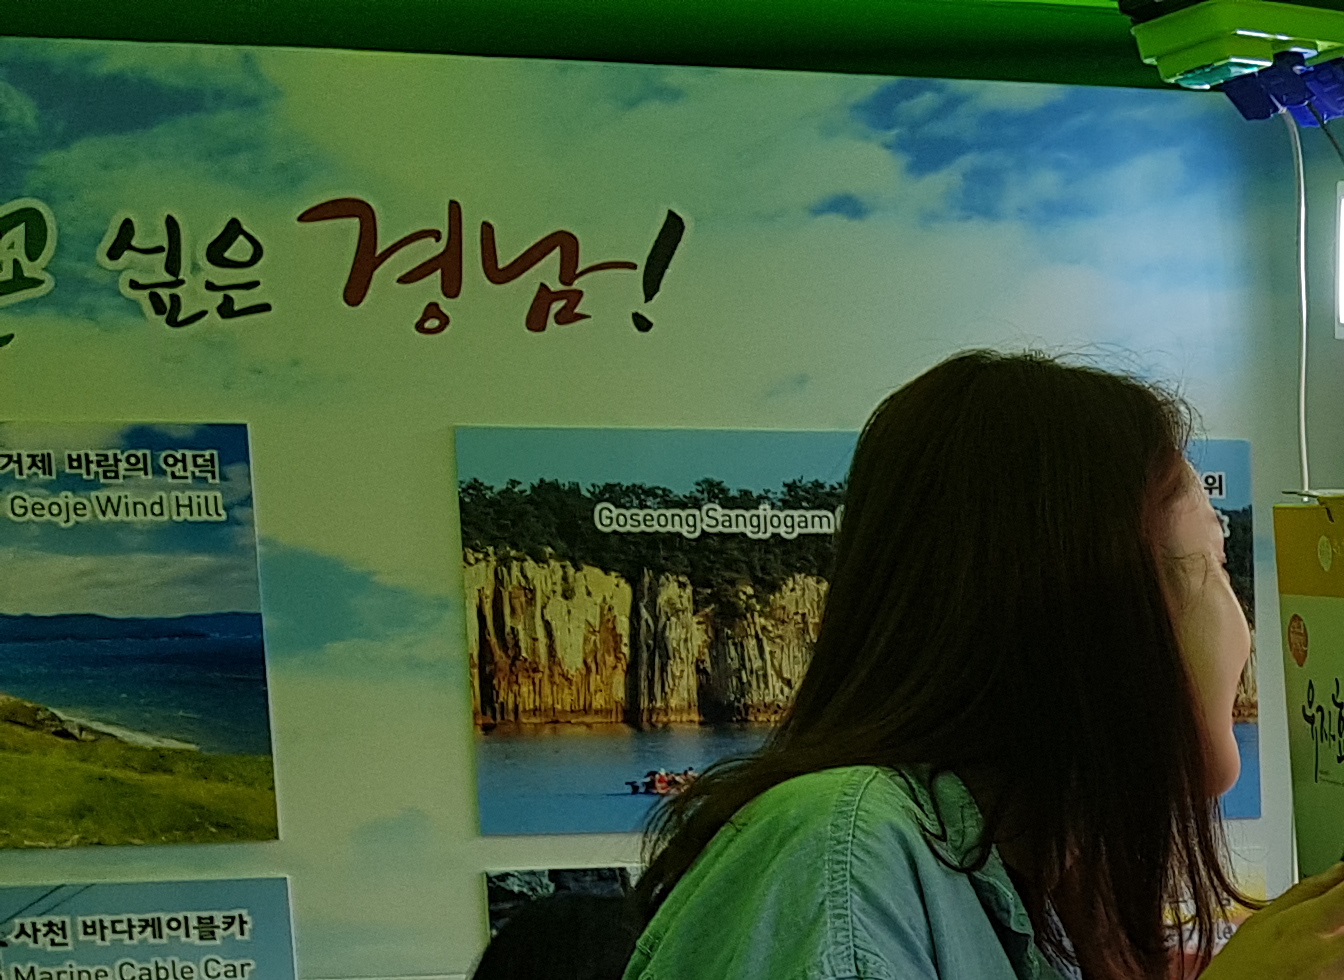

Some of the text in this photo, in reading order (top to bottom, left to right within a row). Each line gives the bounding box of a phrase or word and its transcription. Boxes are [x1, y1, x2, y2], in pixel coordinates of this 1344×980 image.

[106, 214, 272, 328] 싶은
[297, 197, 686, 335] 경남!
[0, 452, 217, 481] 거제 바람의 언덕
[10, 494, 223, 524] Geoje Wind Hill
[599, 504, 831, 534] Goseong Sangjogam
[14, 912, 249, 947] 사천 바다케이블카
[204, 957, 252, 980] Car
